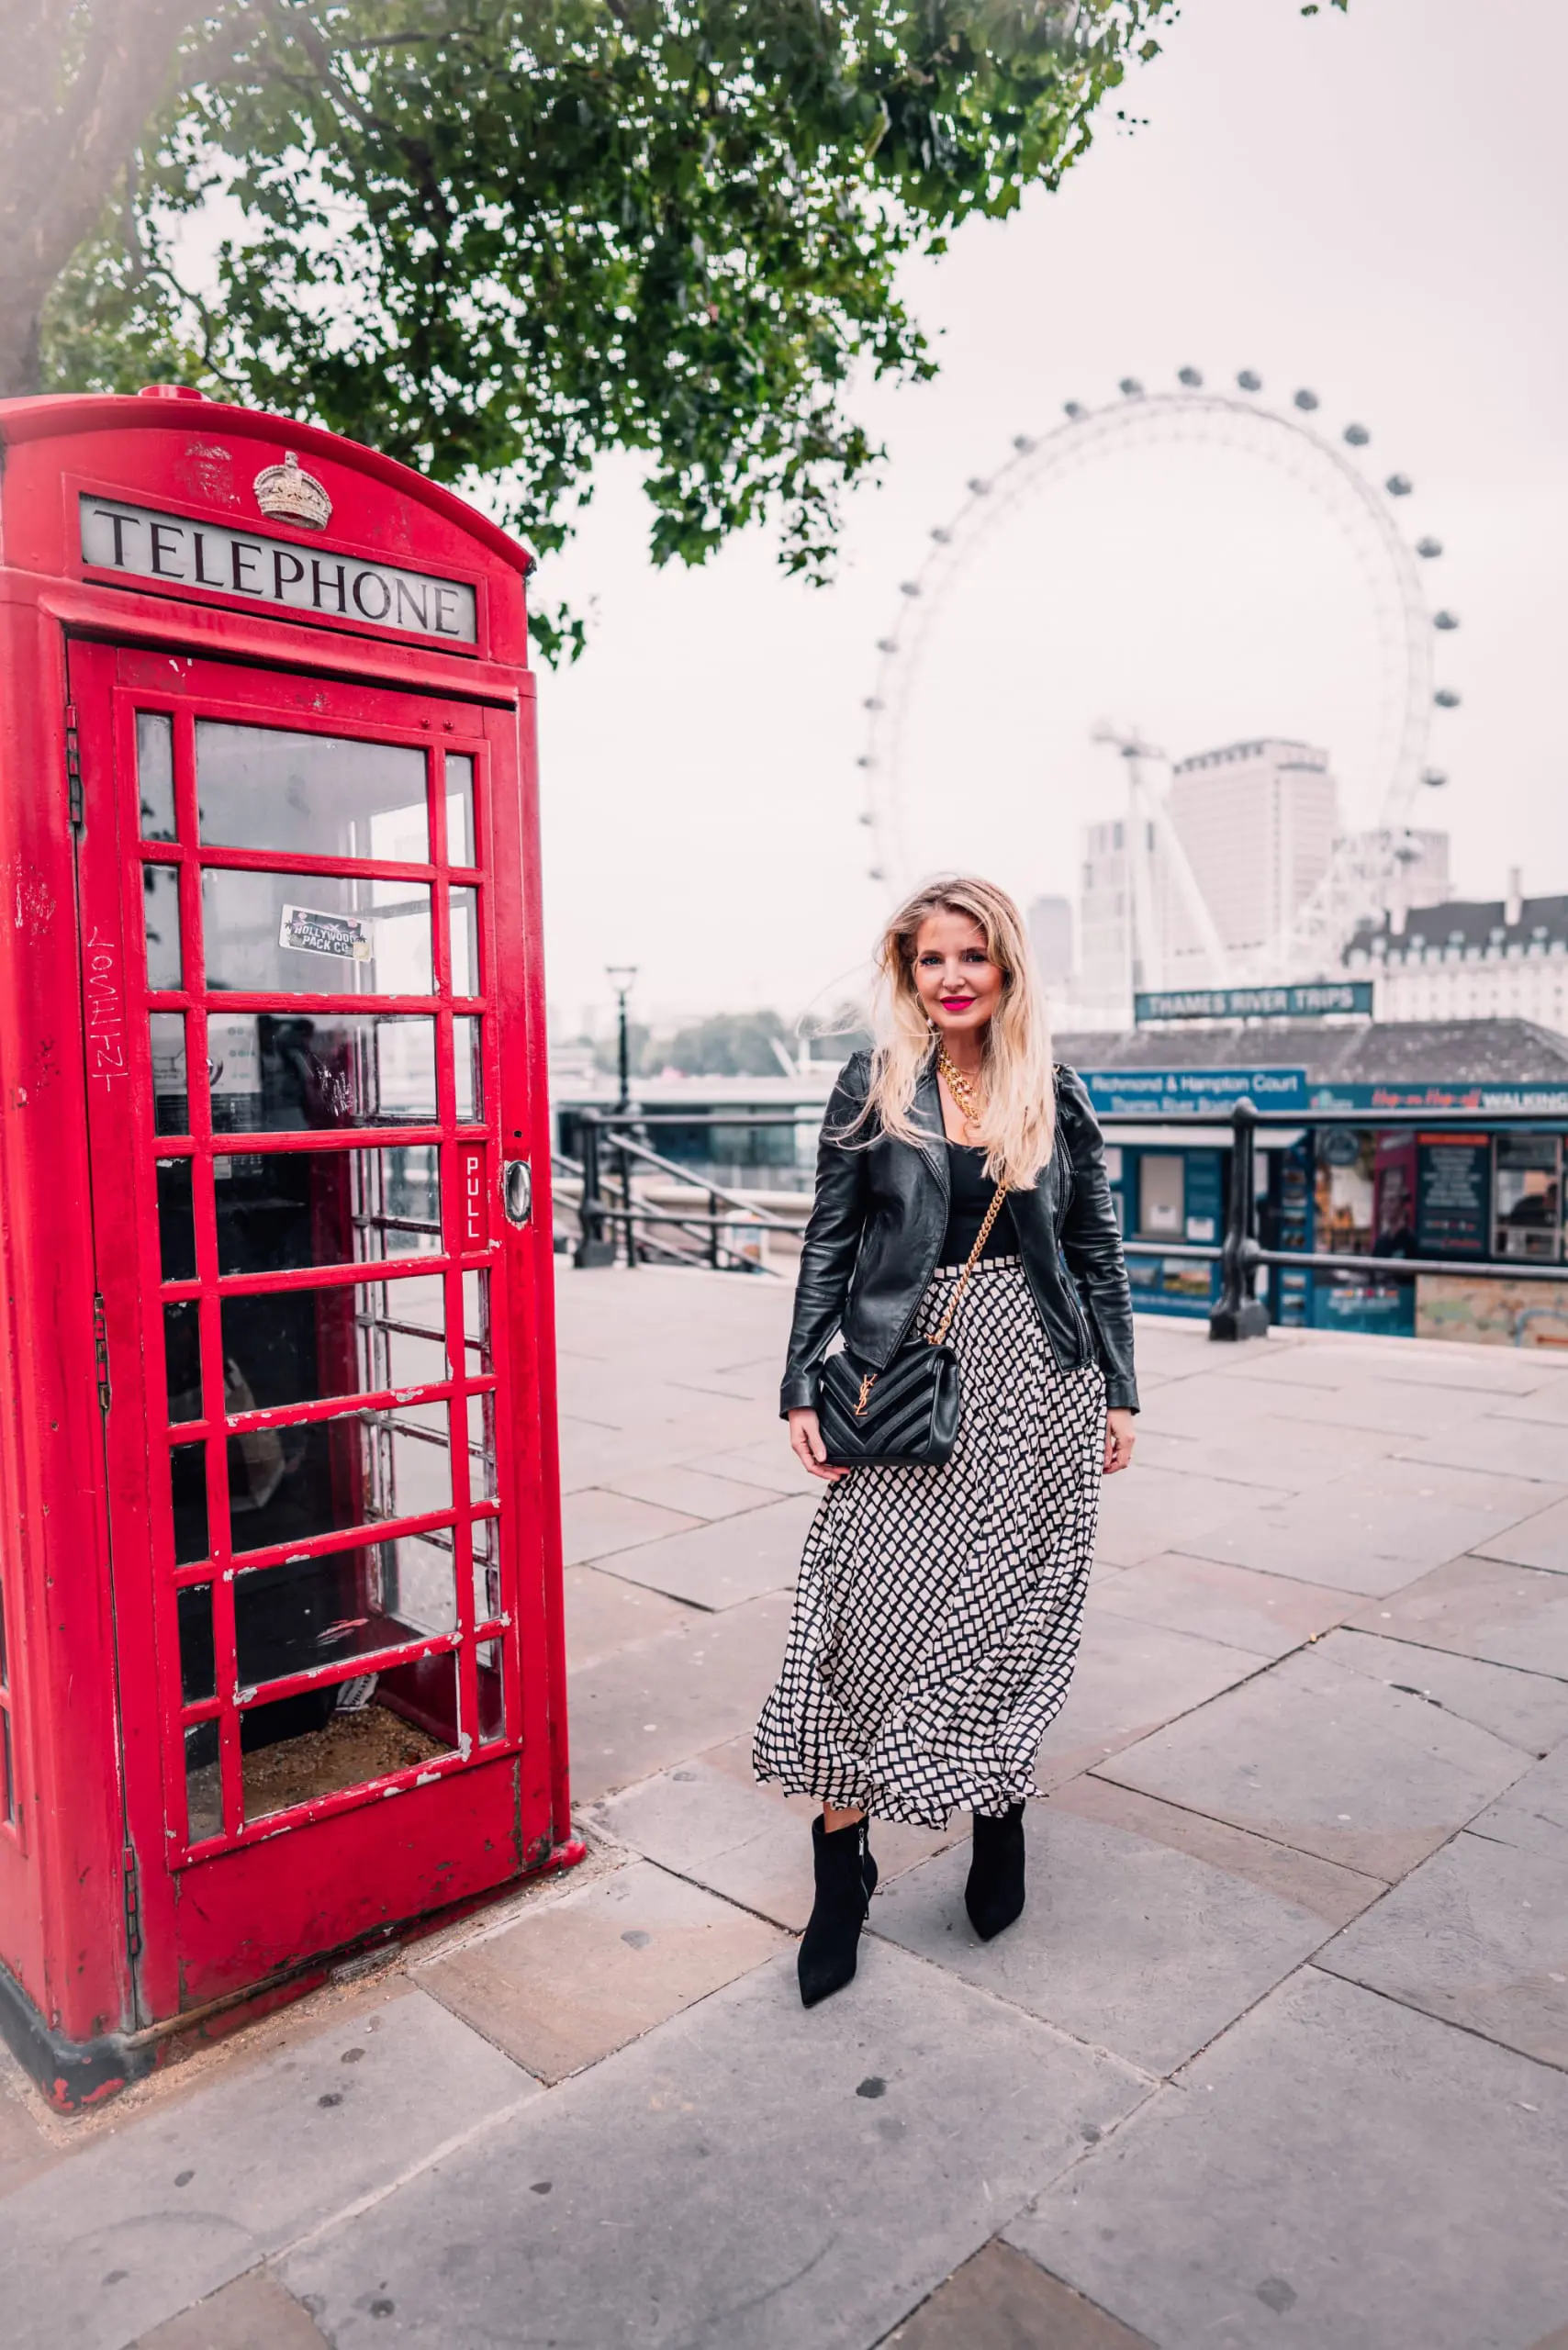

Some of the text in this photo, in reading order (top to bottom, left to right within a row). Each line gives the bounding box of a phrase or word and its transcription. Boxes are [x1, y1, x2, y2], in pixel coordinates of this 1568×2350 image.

[94, 509, 460, 634] TELEPHONE
[294, 924, 356, 944] HOLLYWOOD
[302, 934, 331, 951] PACK
[1149, 986, 1354, 1013] THAMES RIVER TRIPS
[1092, 1073, 1298, 1095] Richmond & Hampton Court
[1482, 1091, 1568, 1110] WALKING
[467, 1157, 480, 1238] PULL
[854, 1373, 878, 1416] YSL
